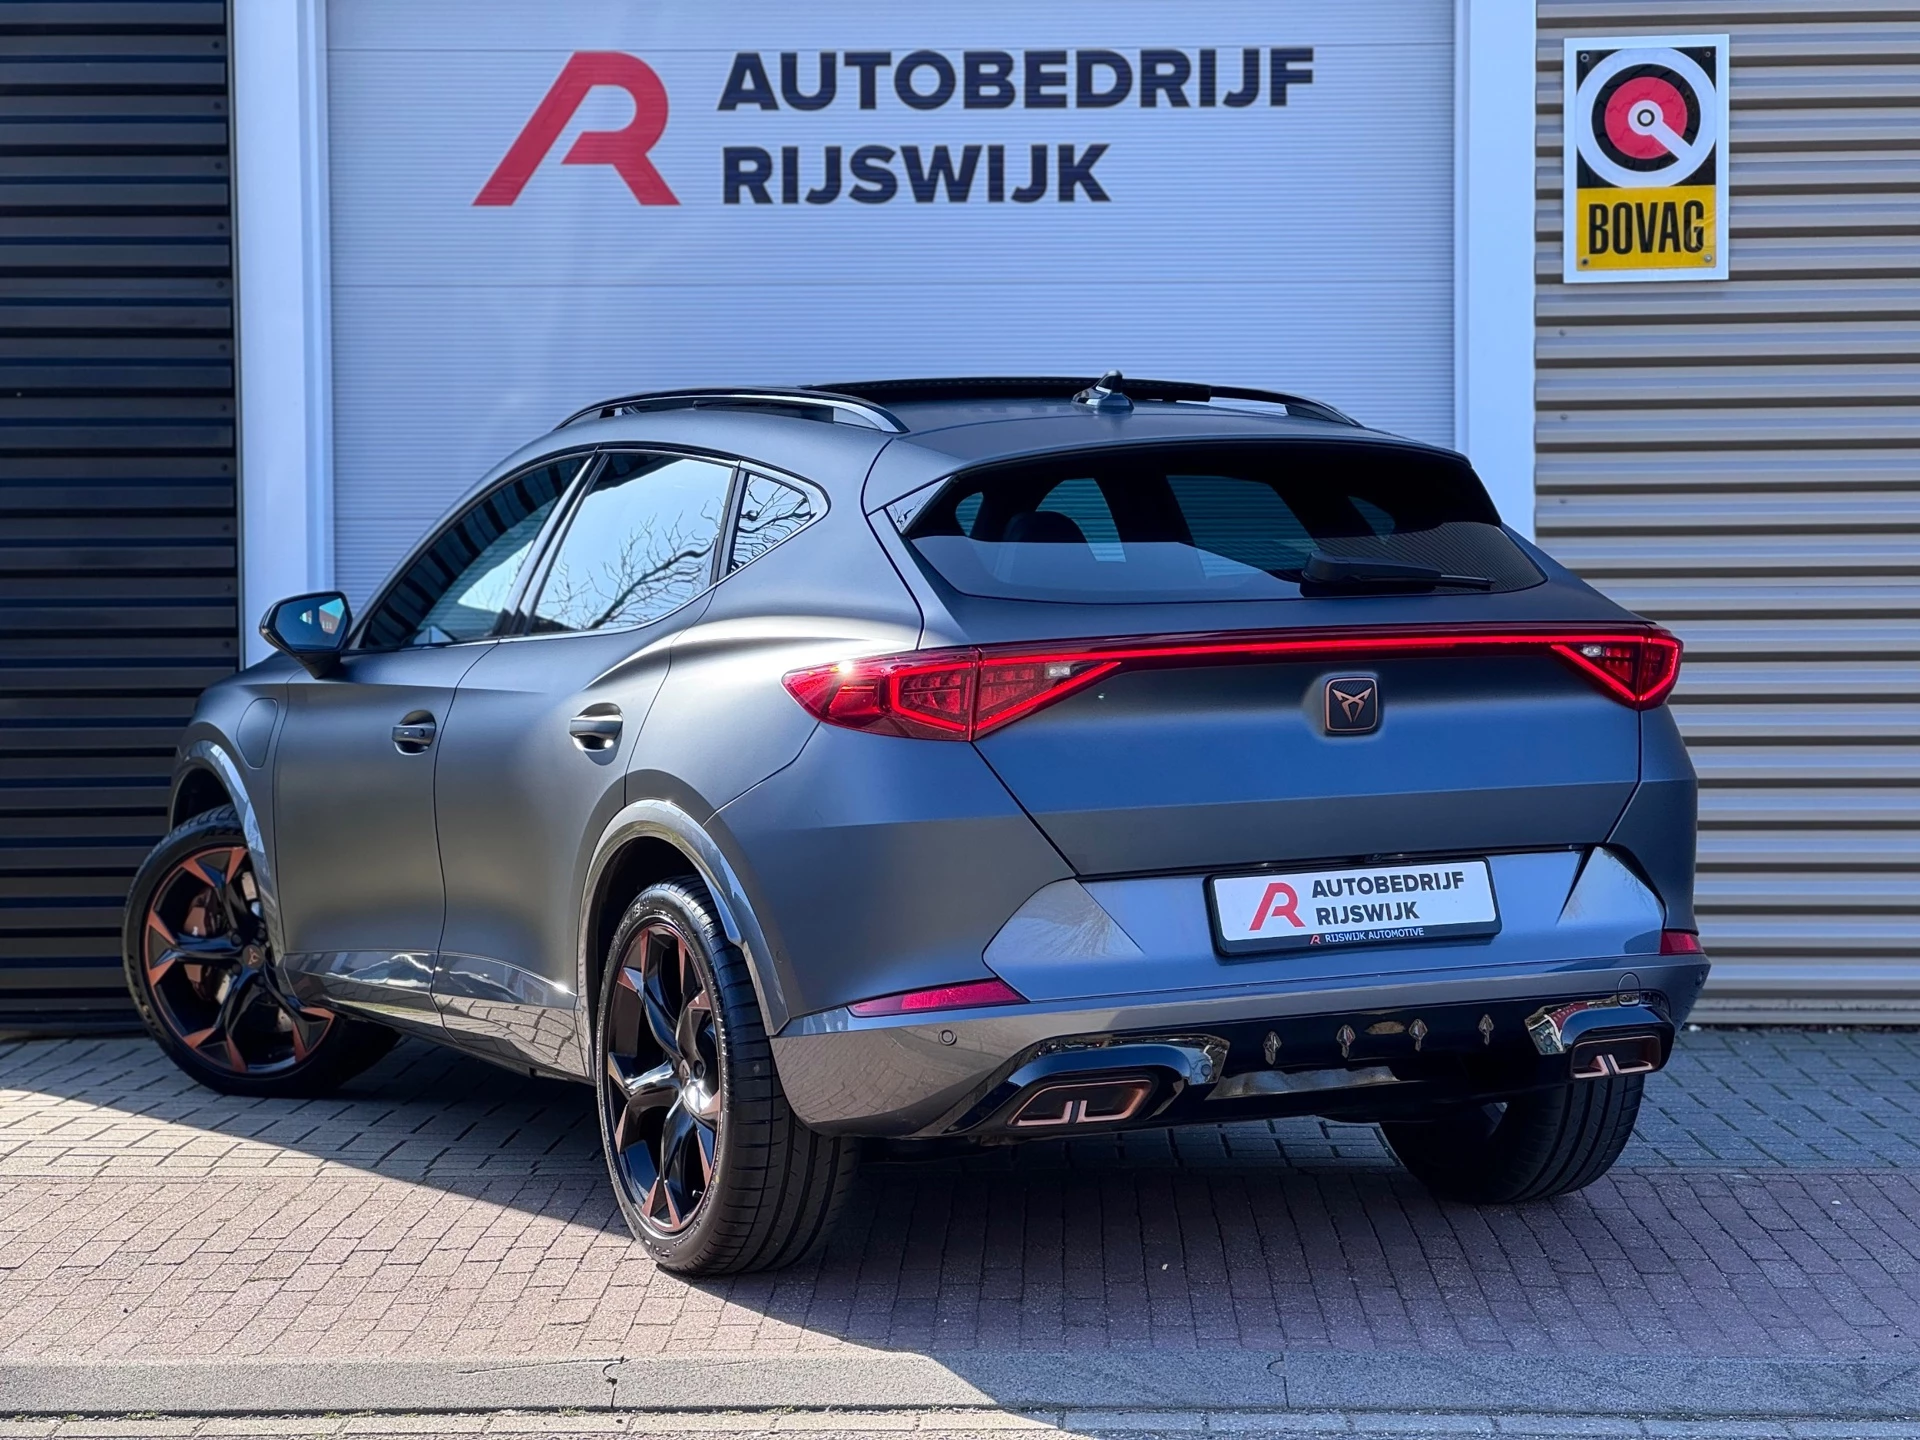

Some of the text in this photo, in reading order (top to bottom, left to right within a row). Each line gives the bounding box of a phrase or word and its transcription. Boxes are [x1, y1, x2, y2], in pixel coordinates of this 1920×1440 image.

[717, 47, 1314, 112] AUTOBEDRIJF
[722, 143, 1112, 205] RIJSWIJK
[1588, 200, 1704, 255] BOVAG
[1312, 871, 1464, 898] AUTOBEDRIJF
[1316, 901, 1420, 926] RIJSWIJK
[1325, 932, 1366, 943] RIJSWIJK
[1368, 927, 1425, 940] AUTOMOTIVE
